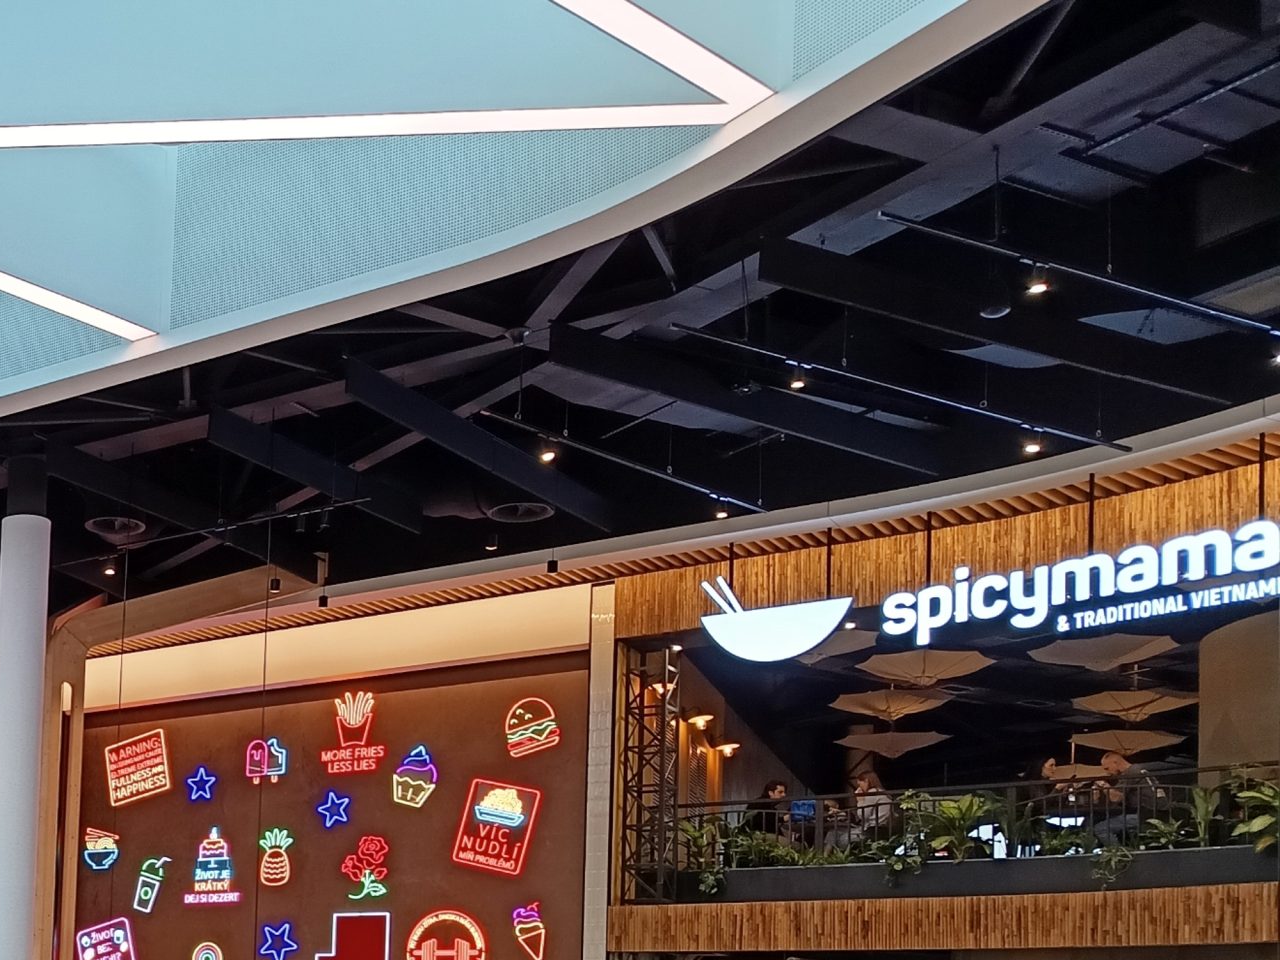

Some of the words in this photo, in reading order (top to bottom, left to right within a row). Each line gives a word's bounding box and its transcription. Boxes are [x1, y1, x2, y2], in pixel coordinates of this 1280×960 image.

[882, 519, 1280, 645] spicymama
[1057, 616, 1070, 633] &
[1074, 594, 1188, 629] TRADITIONAL
[321, 748, 353, 762] MORE
[354, 745, 385, 759] FRIES
[328, 761, 352, 773] LESS
[354, 759, 377, 771] LIES
[111, 768, 152, 788] FULLNESS
[112, 774, 166, 800] HAPPINESS
[480, 823, 510, 842] VÍC
[461, 835, 522, 859] NUDLÍ
[195, 868, 219, 880] ŽIVOT
[220, 869, 230, 879] JE
[195, 879, 230, 892] KRÁTKÝ
[184, 893, 200, 904] DEJ
[200, 893, 207, 903] SI
[208, 892, 240, 903] DEZERT
